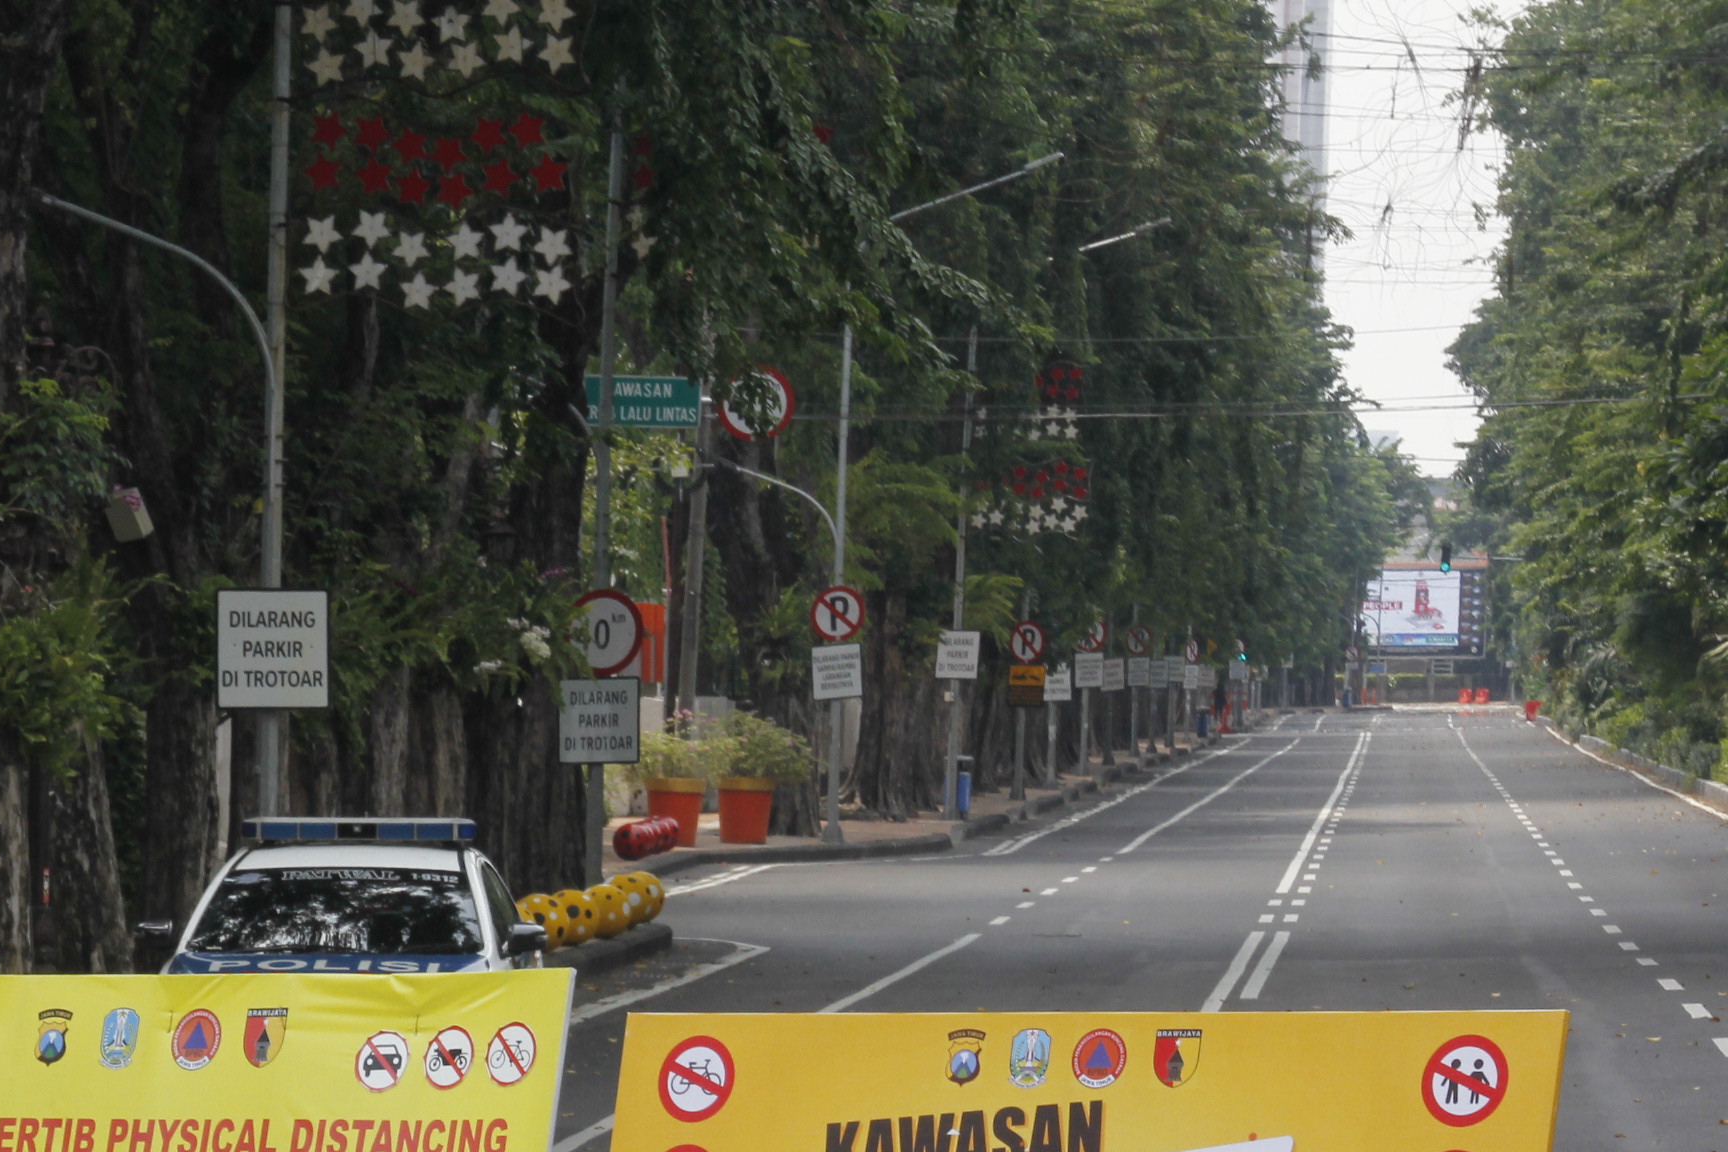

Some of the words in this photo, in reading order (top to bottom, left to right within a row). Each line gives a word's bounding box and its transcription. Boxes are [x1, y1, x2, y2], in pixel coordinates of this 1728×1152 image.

[614, 382, 672, 398] AWASAN
[620, 406, 652, 421] LALU
[655, 406, 697, 423] LINTAS
[229, 611, 316, 629] DILARANG
[594, 618, 610, 650] 0
[611, 612, 626, 624] km
[242, 641, 303, 658] PARKIR
[222, 671, 239, 688] DI
[245, 671, 324, 688] TROTOAR
[569, 691, 628, 707] DILARANG
[578, 713, 619, 728] PARKIR
[564, 736, 577, 751] DI
[580, 735, 633, 751] TROTOAR
[281, 869, 401, 881] PATWAL
[208, 957, 442, 974] POLISI
[247, 1009, 287, 1017] BRAWIJAYA
[1157, 1030, 1202, 1038] BRAWIJAYA
